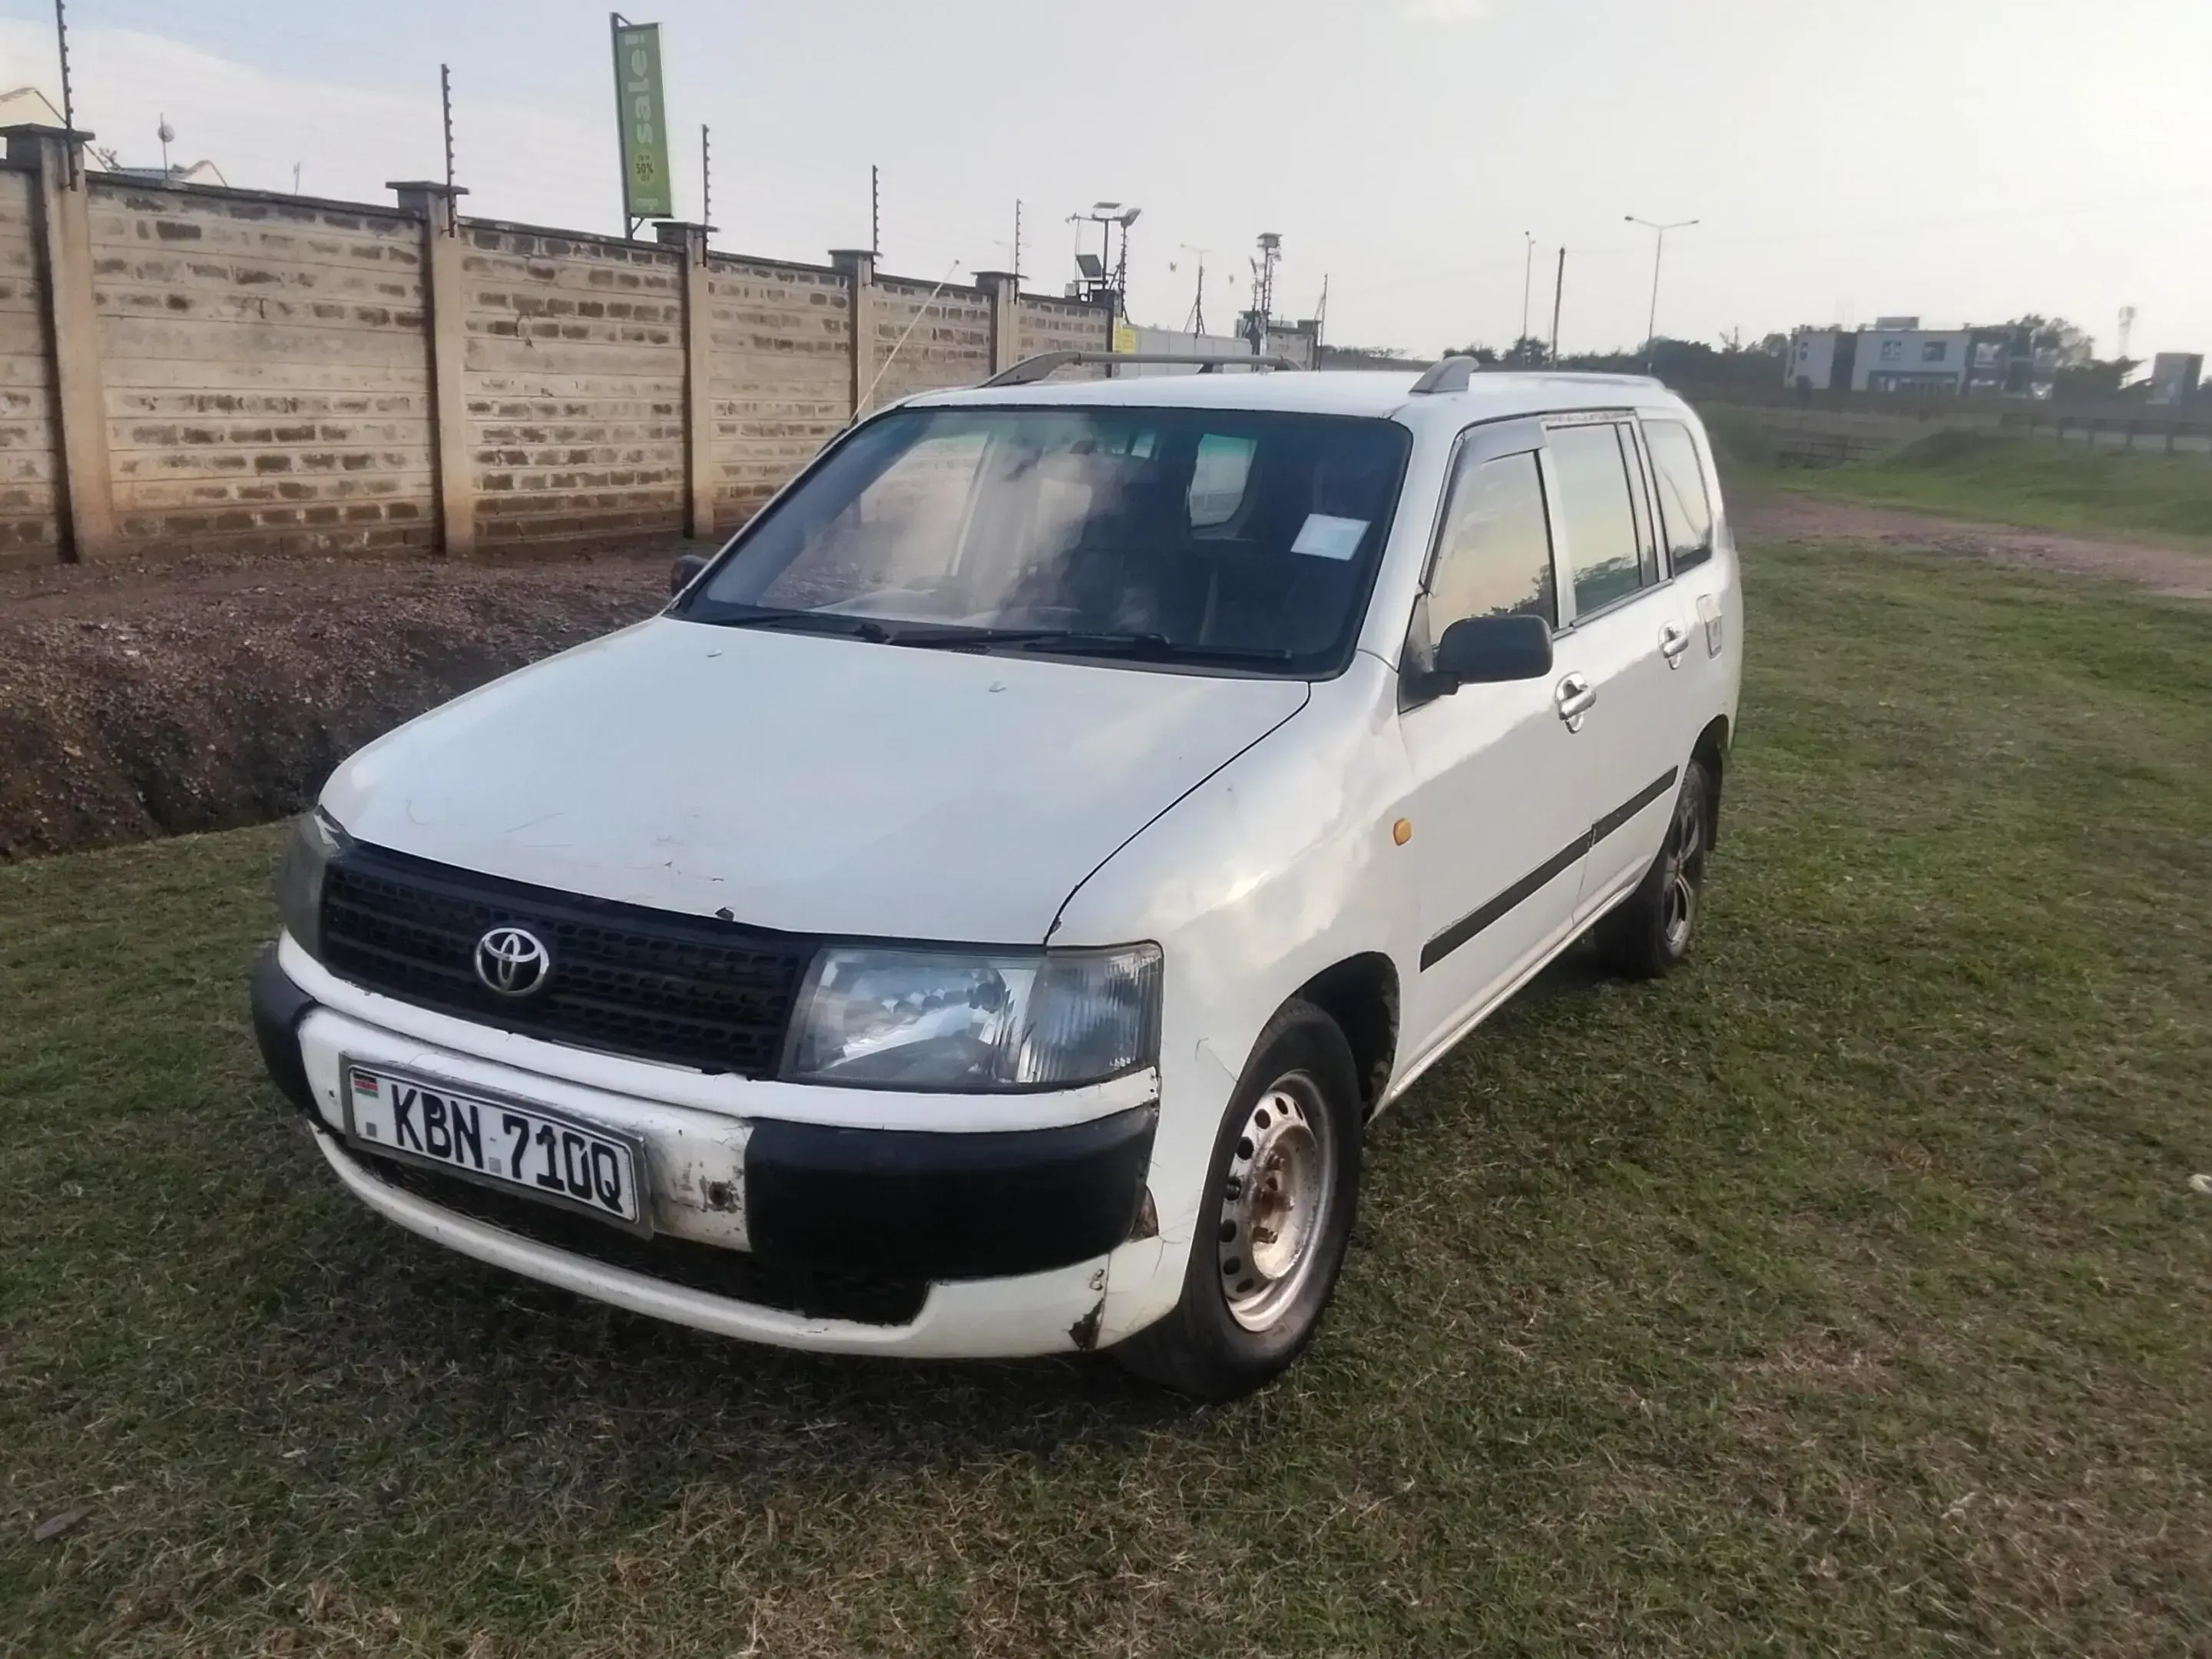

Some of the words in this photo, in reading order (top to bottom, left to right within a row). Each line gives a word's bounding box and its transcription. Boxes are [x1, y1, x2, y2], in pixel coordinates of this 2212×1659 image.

[636, 162, 654, 174] 50%
[391, 1084, 484, 1170] KBN
[502, 1113, 624, 1214] 710Q
